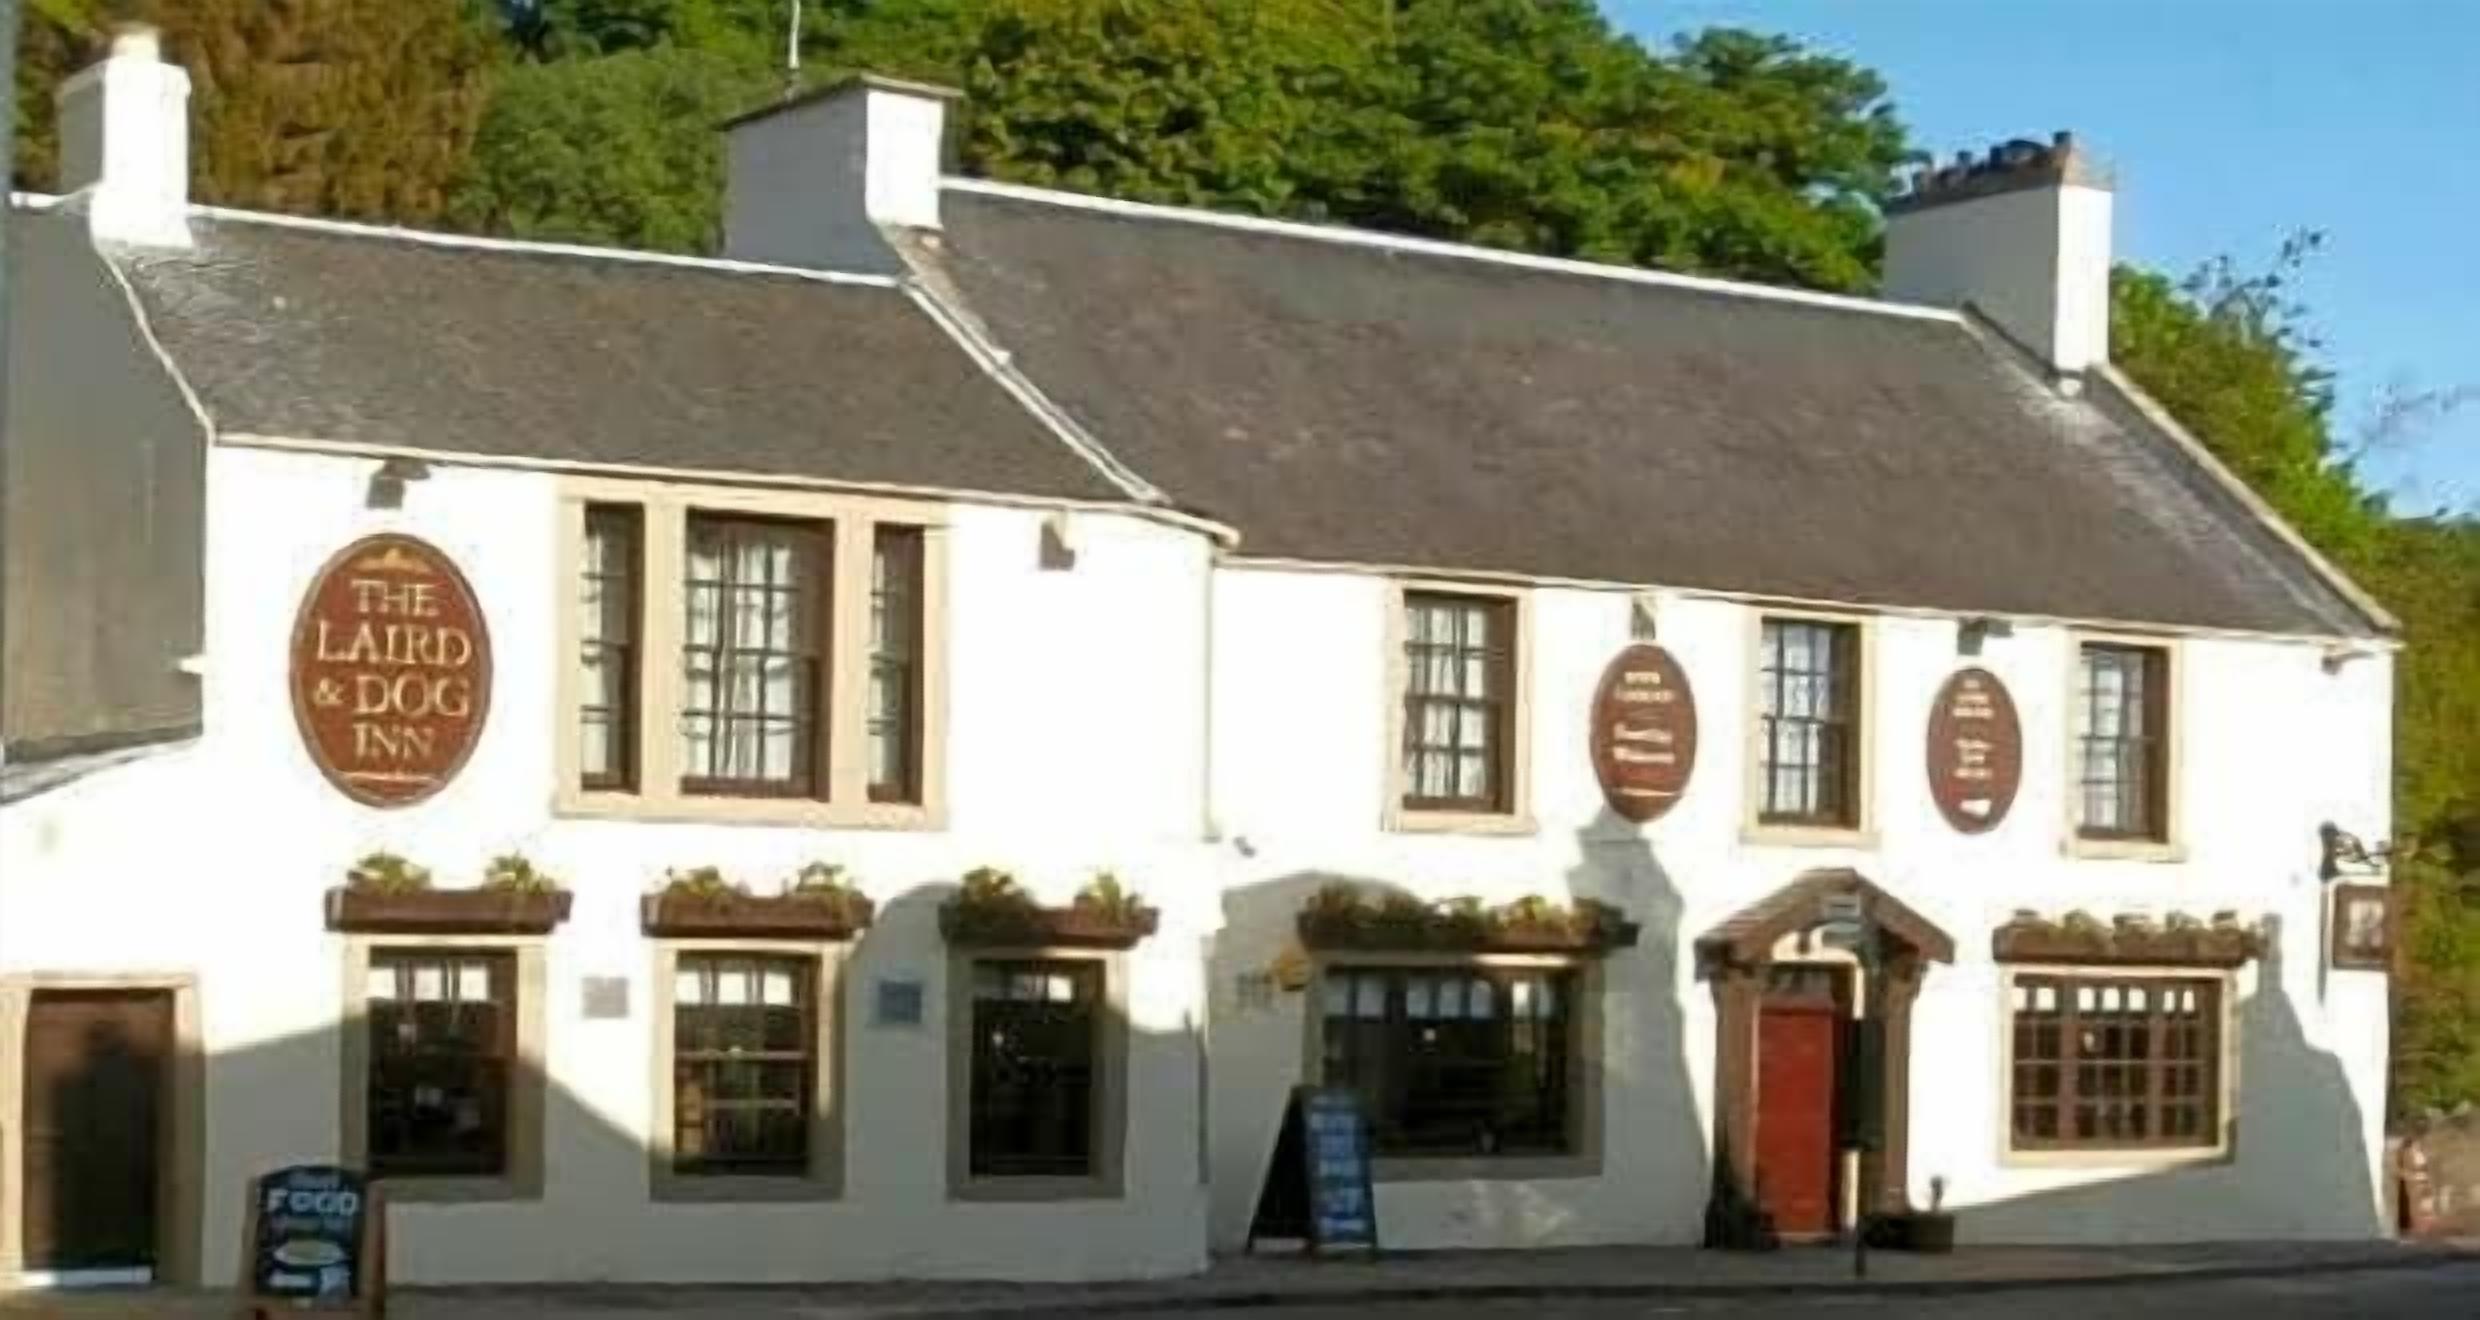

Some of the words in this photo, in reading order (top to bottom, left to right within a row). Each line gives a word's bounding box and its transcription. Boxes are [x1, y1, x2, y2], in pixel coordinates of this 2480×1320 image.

[351, 580, 441, 618] THE
[317, 619, 473, 665] LAIRD
[313, 677, 345, 706] &
[353, 672, 470, 718] DOG
[351, 722, 436, 760] INN
[267, 1187, 359, 1216] FOOD
